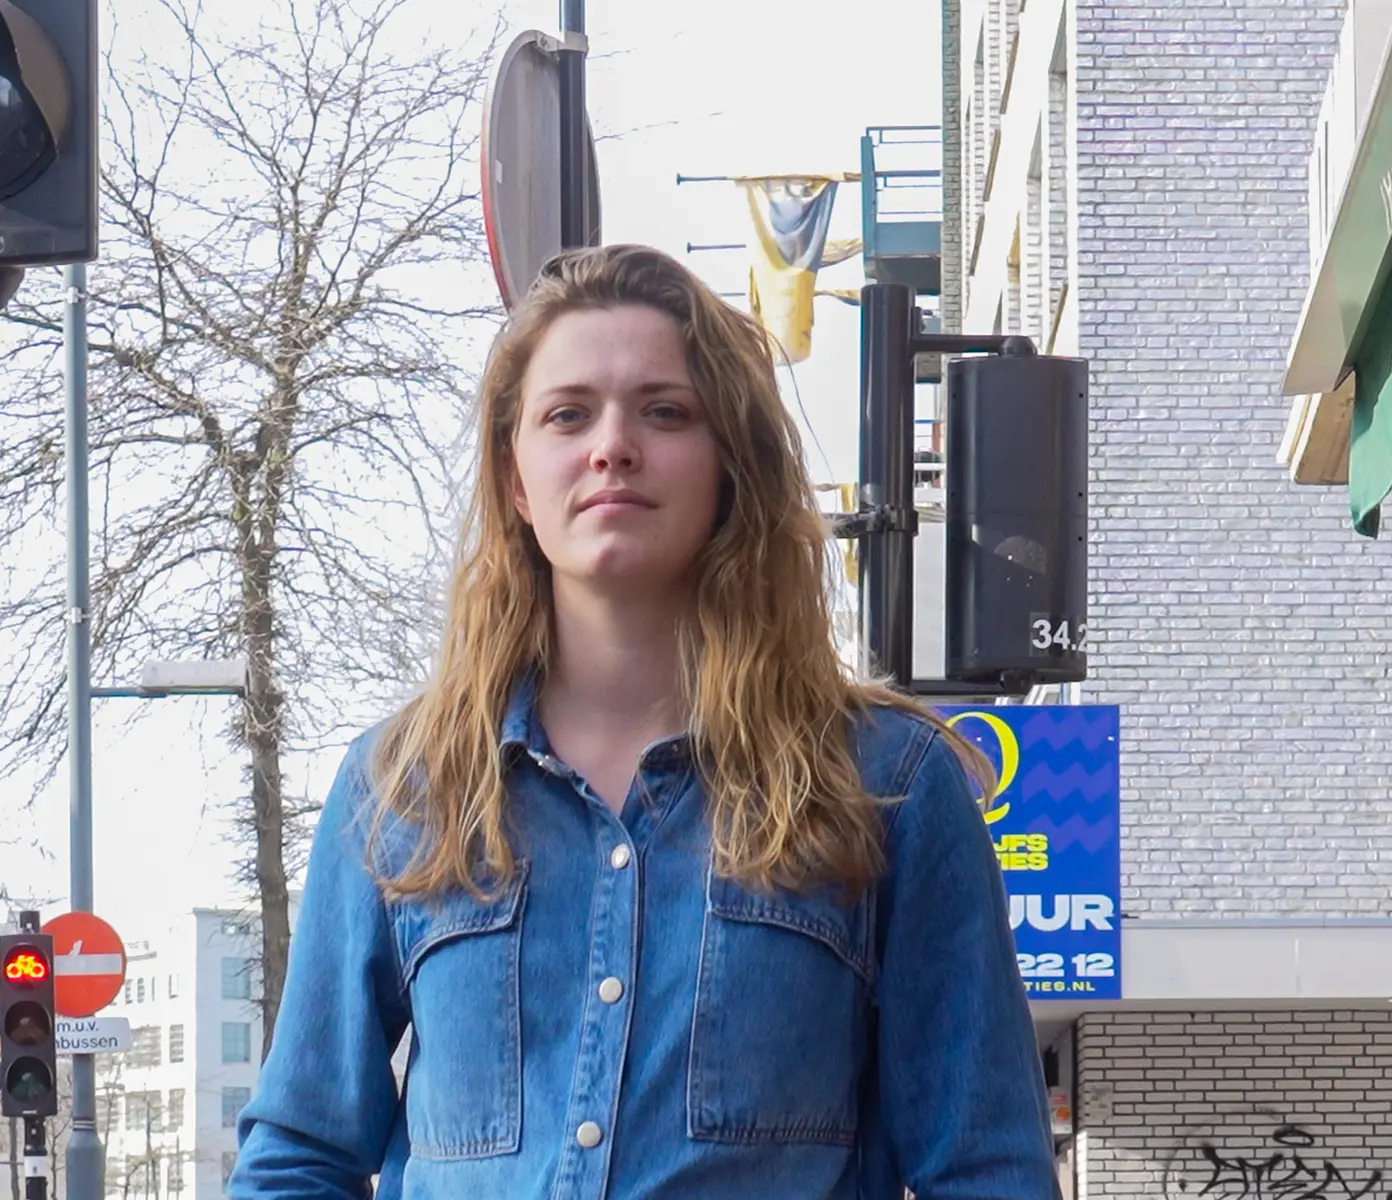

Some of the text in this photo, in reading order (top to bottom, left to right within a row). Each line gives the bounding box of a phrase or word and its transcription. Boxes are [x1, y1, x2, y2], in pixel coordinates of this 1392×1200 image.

[993, 834, 1048, 852] JFS
[1071, 953, 1115, 977] 12
[1024, 981, 1096, 991] TIES.NL
[57, 1021, 99, 1032] m.u.v.
